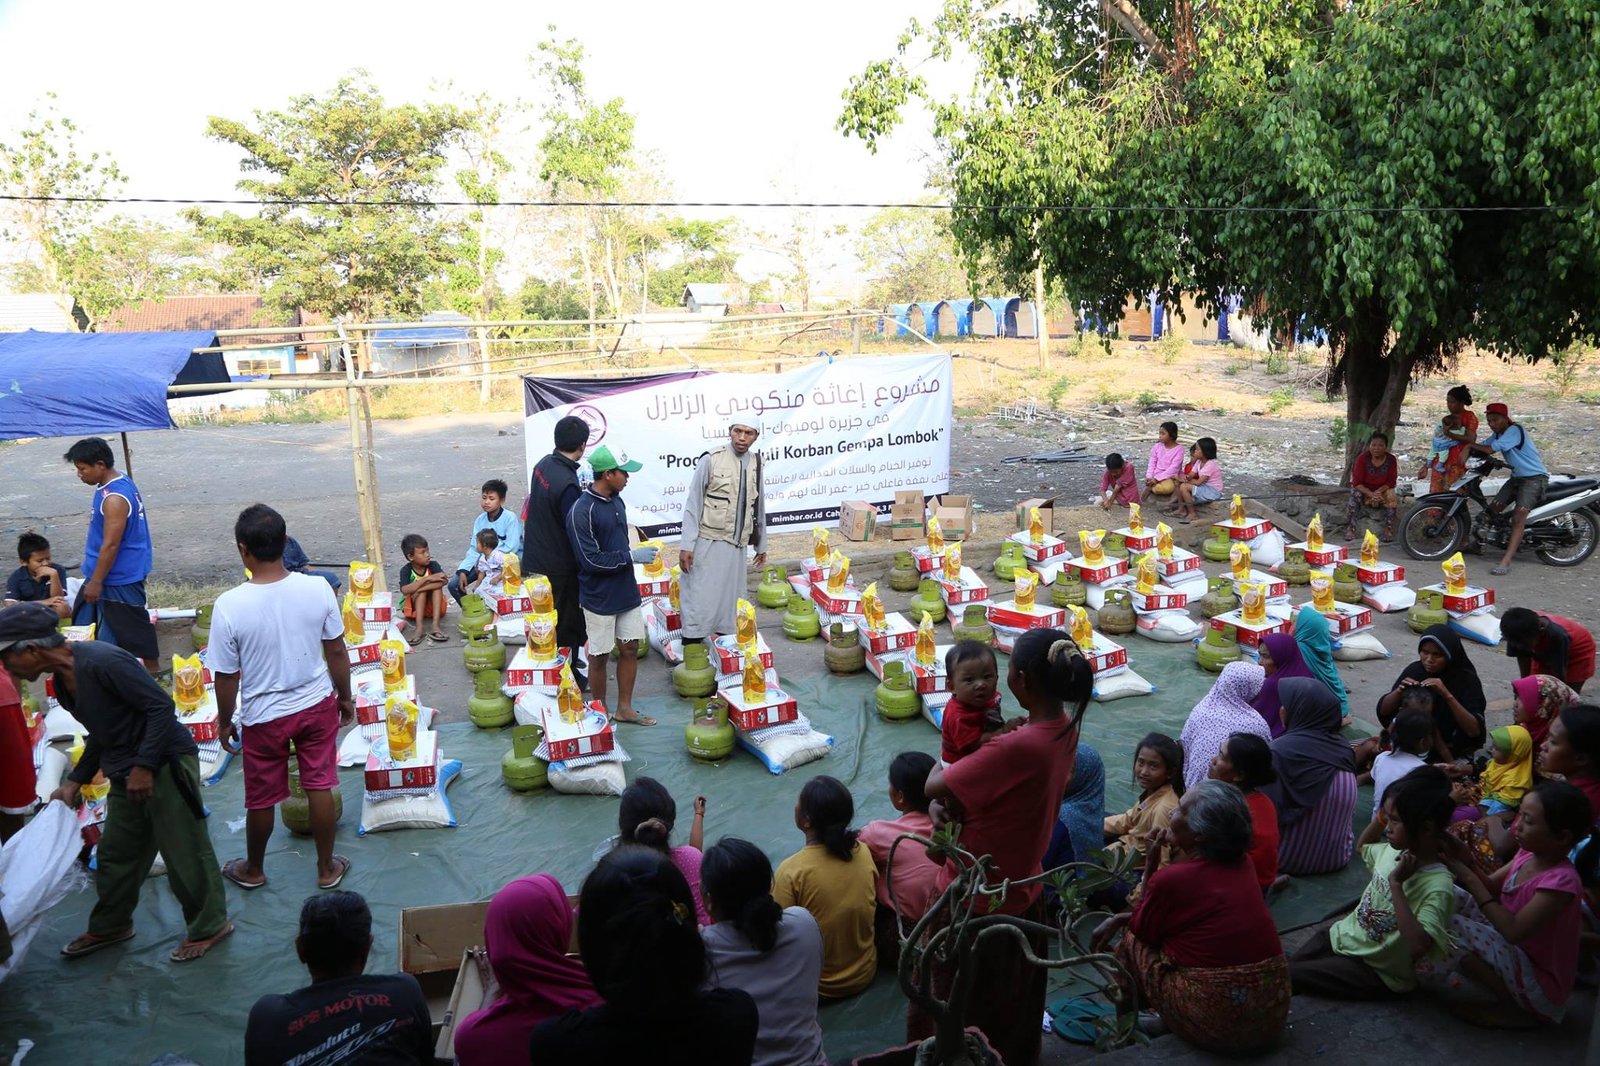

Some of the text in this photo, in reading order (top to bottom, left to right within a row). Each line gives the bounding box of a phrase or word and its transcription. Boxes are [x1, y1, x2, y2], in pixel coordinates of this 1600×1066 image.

[646, 375, 940, 421] مشروع إغاثة منكوبي الزلازل
[828, 415, 863, 432] جزيرة
[866, 412, 890, 428] في
[784, 443, 833, 459] Korban
[837, 437, 884, 454] Gempa
[888, 428, 944, 446] Lombok”
[662, 481, 686, 496] شهر
[810, 483, 827, 496] الله
[771, 511, 823, 524] mimbar.or.id
[324, 990, 393, 1016] MOTOR
